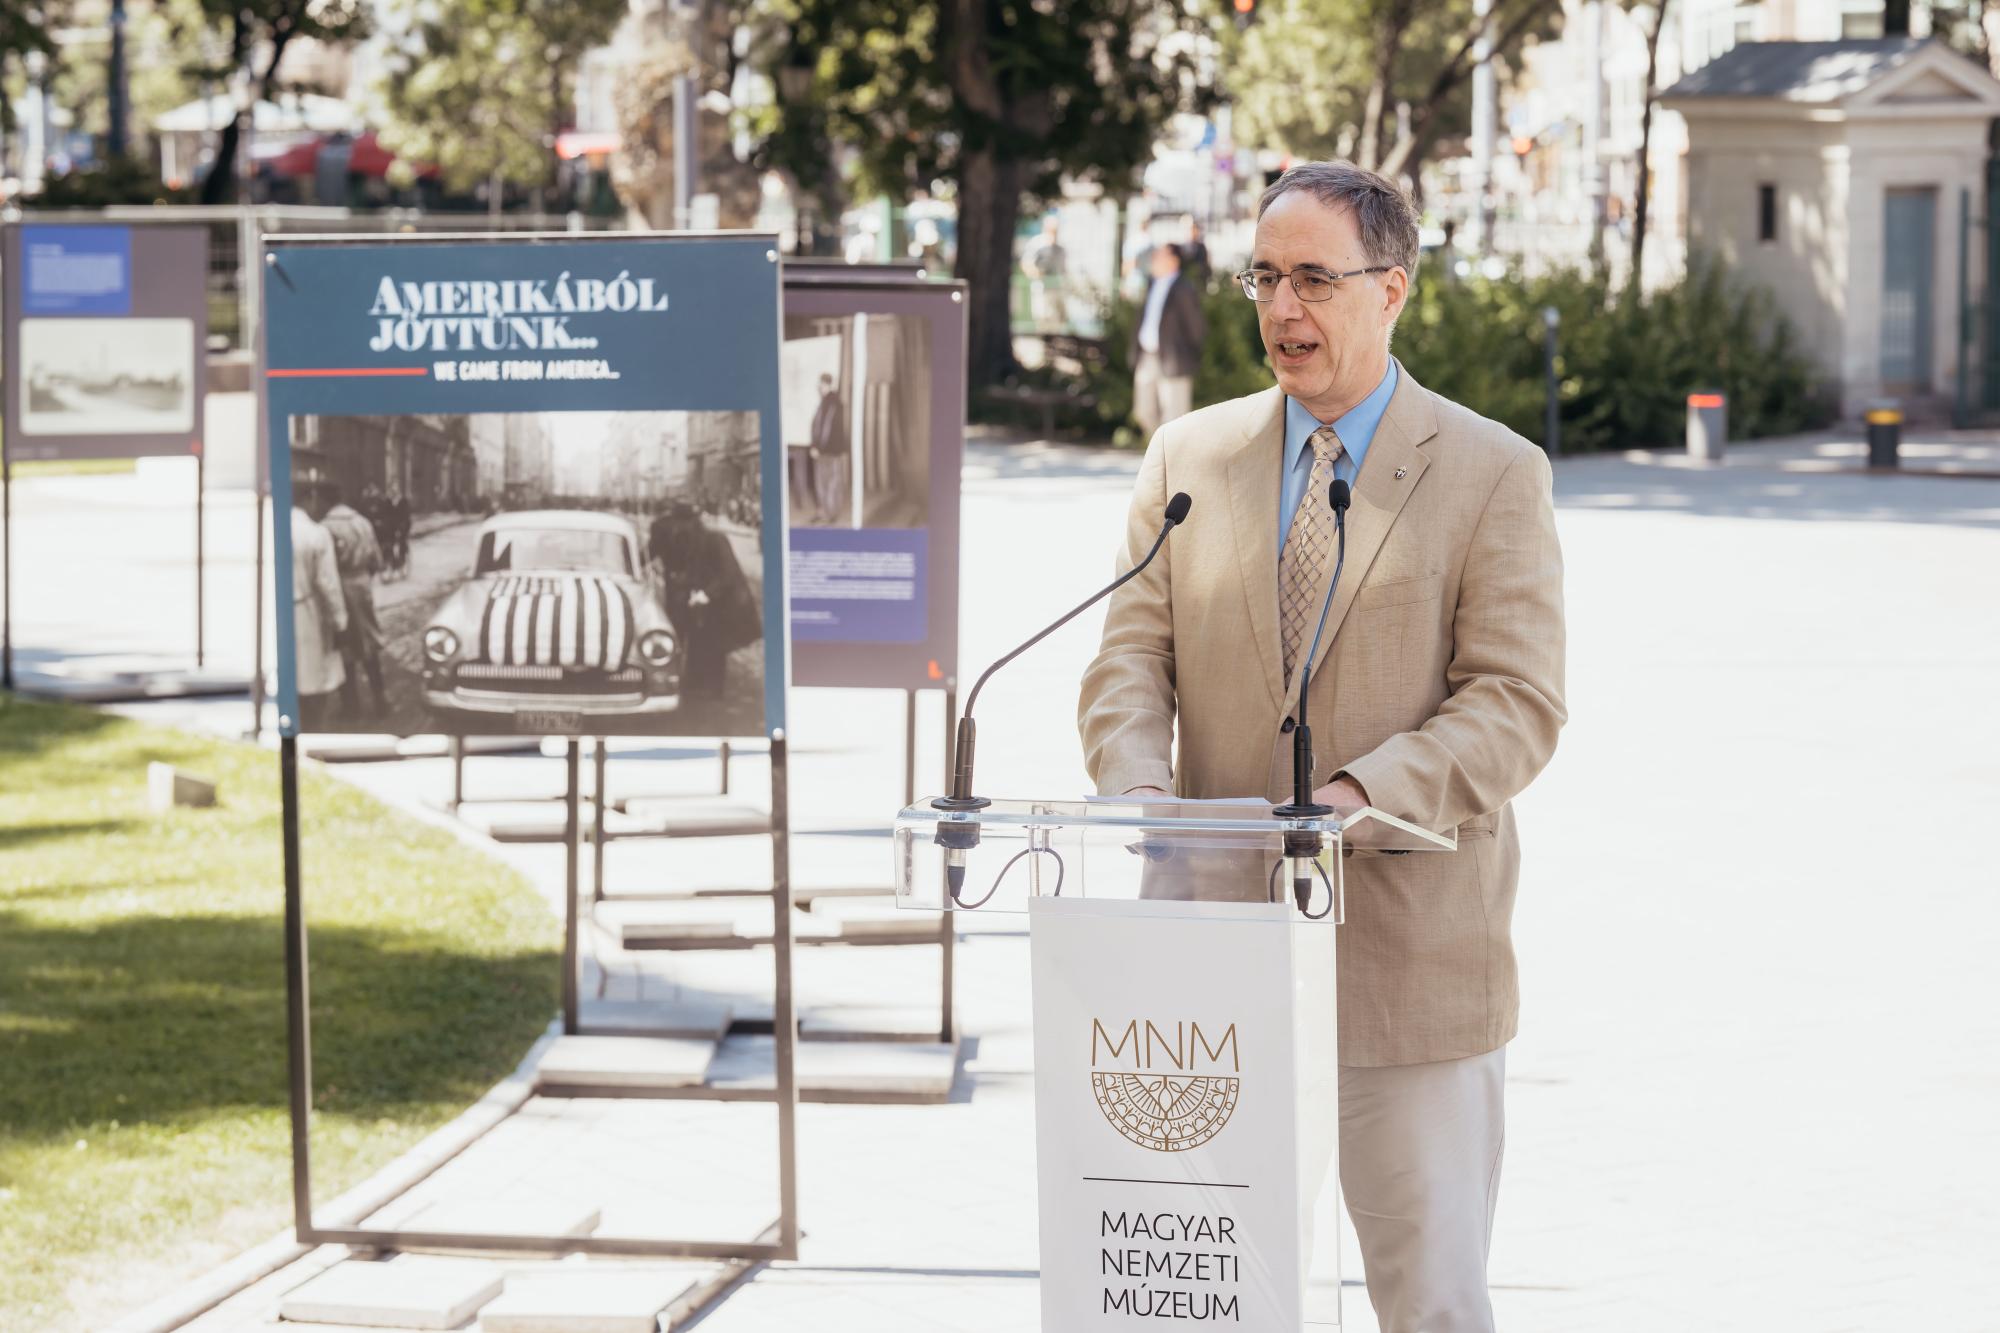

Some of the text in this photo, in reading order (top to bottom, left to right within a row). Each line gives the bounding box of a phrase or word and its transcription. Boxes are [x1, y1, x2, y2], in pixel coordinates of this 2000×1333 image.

[368, 270, 669, 315] AMERIKÁBÓL
[369, 307, 599, 352] JÖTTÜNK...
[433, 361, 457, 381] WE
[459, 361, 500, 381] CAME
[502, 360, 543, 380] FROM
[1091, 1017, 1240, 1073] MNM
[1101, 1210, 1236, 1244] MAGYAR
[1102, 1248, 1239, 1283] NEMZETI
[1103, 1283, 1240, 1322] MÚZEUM
